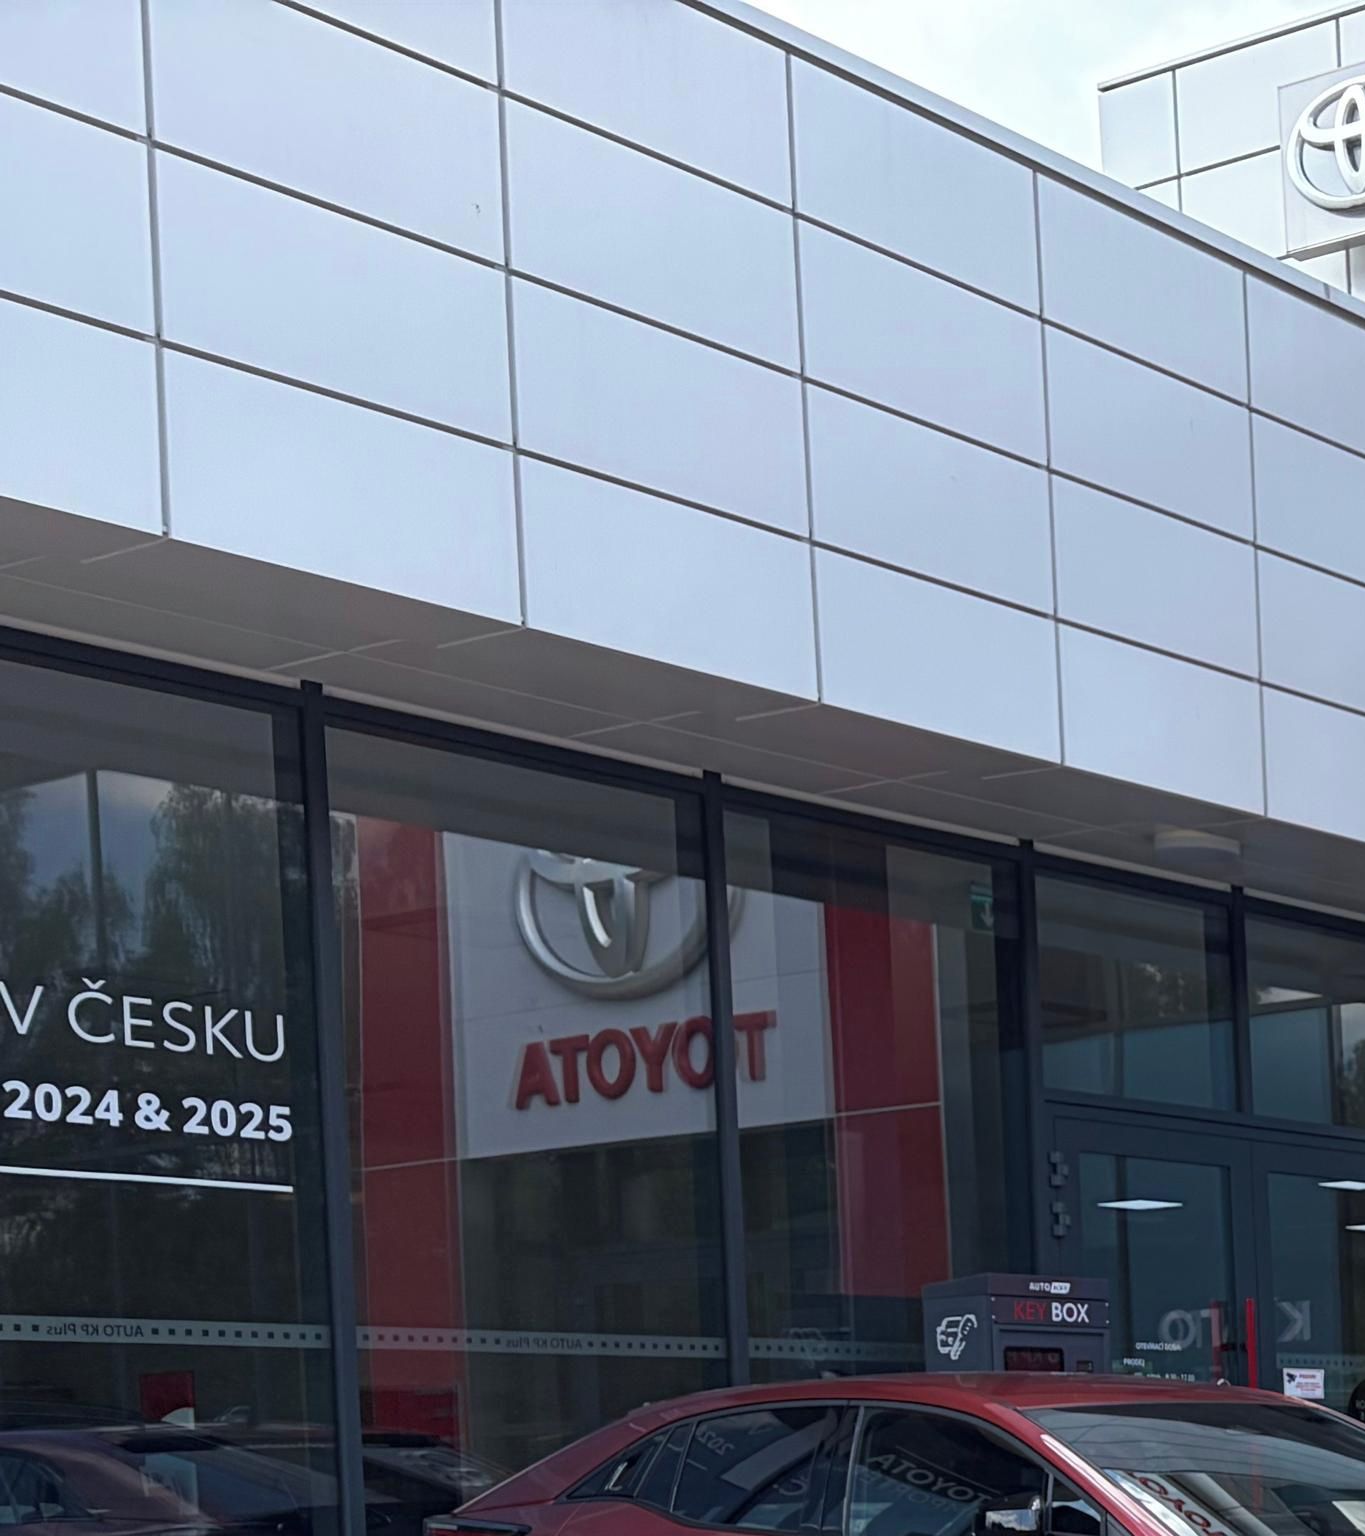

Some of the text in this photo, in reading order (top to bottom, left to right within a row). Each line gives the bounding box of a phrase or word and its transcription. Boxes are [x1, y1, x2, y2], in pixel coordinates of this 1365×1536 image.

[0, 977, 286, 1062] V ČESKU
[2, 1080, 293, 1142] 2024 & 2025
[1013, 1302, 1089, 1323] KEY BOX
